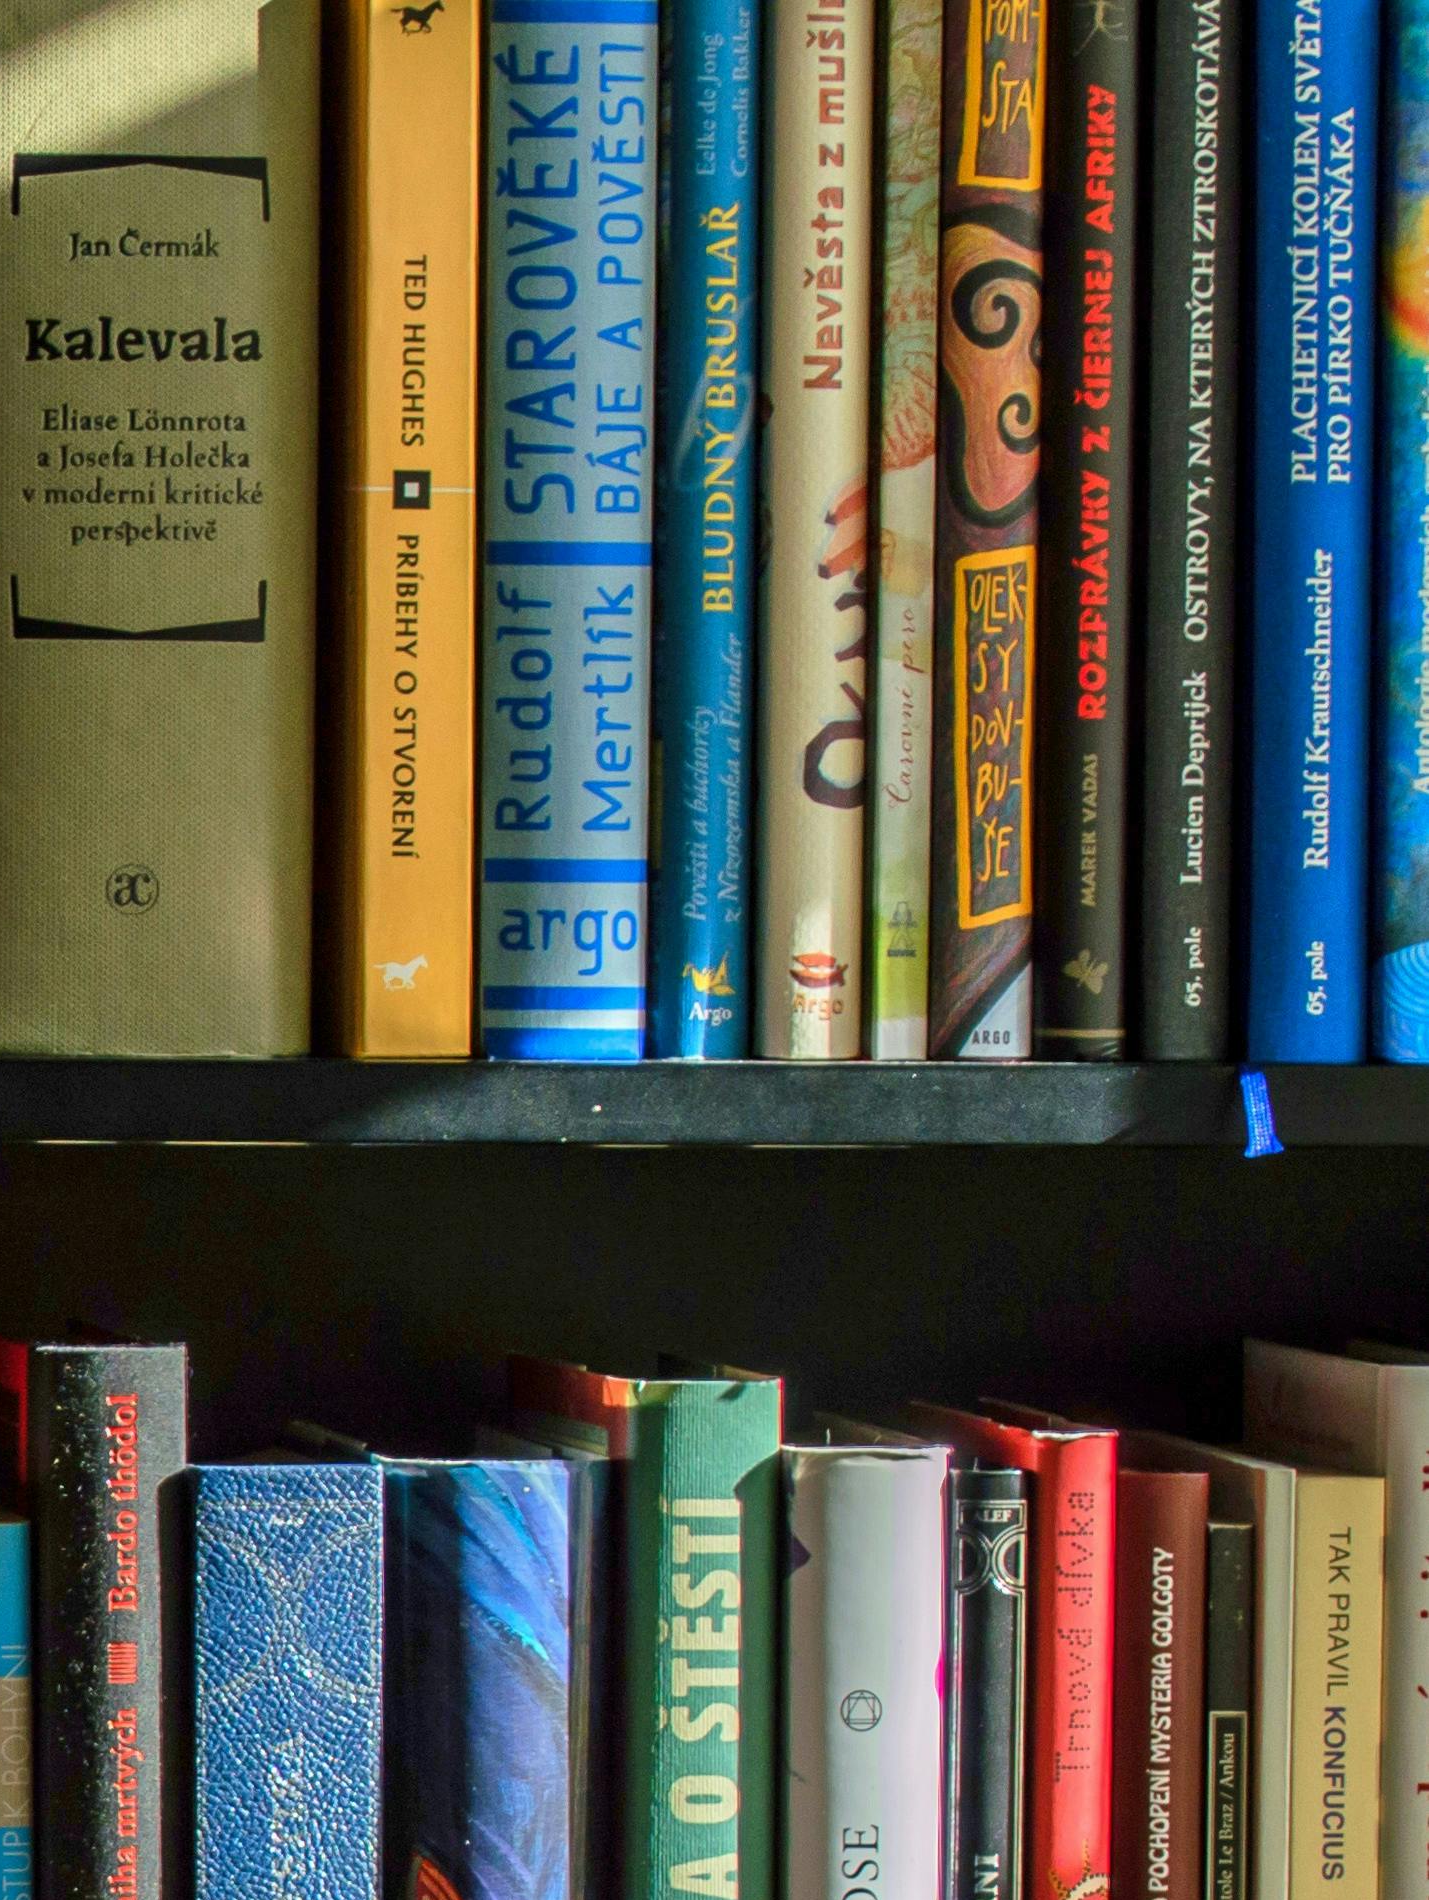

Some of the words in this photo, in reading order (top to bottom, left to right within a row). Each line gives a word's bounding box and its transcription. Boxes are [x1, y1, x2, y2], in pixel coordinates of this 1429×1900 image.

[591, 41, 646, 284] POVĚSTI
[69, 233, 111, 262] Jan
[118, 227, 220, 258] Čermák
[493, 41, 581, 514] STAROVĚKÉ
[24, 316, 263, 365] Kalevala
[598, 317, 643, 352] A
[41, 406, 119, 434] Eliase
[128, 407, 247, 435] Lönnrota
[586, 380, 646, 515] BÁJE
[1303, 548, 1336, 764] Krautschneider
[494, 584, 554, 831] Rudolf
[580, 583, 635, 833] Mertlík
[1179, 793, 1205, 884] Lucien
[1303, 770, 1332, 868] Rudolf
[496, 906, 638, 976] argo
[653, 1495, 734, 1742] ŠTĚSTÍ
[667, 1773, 734, 1824] O
